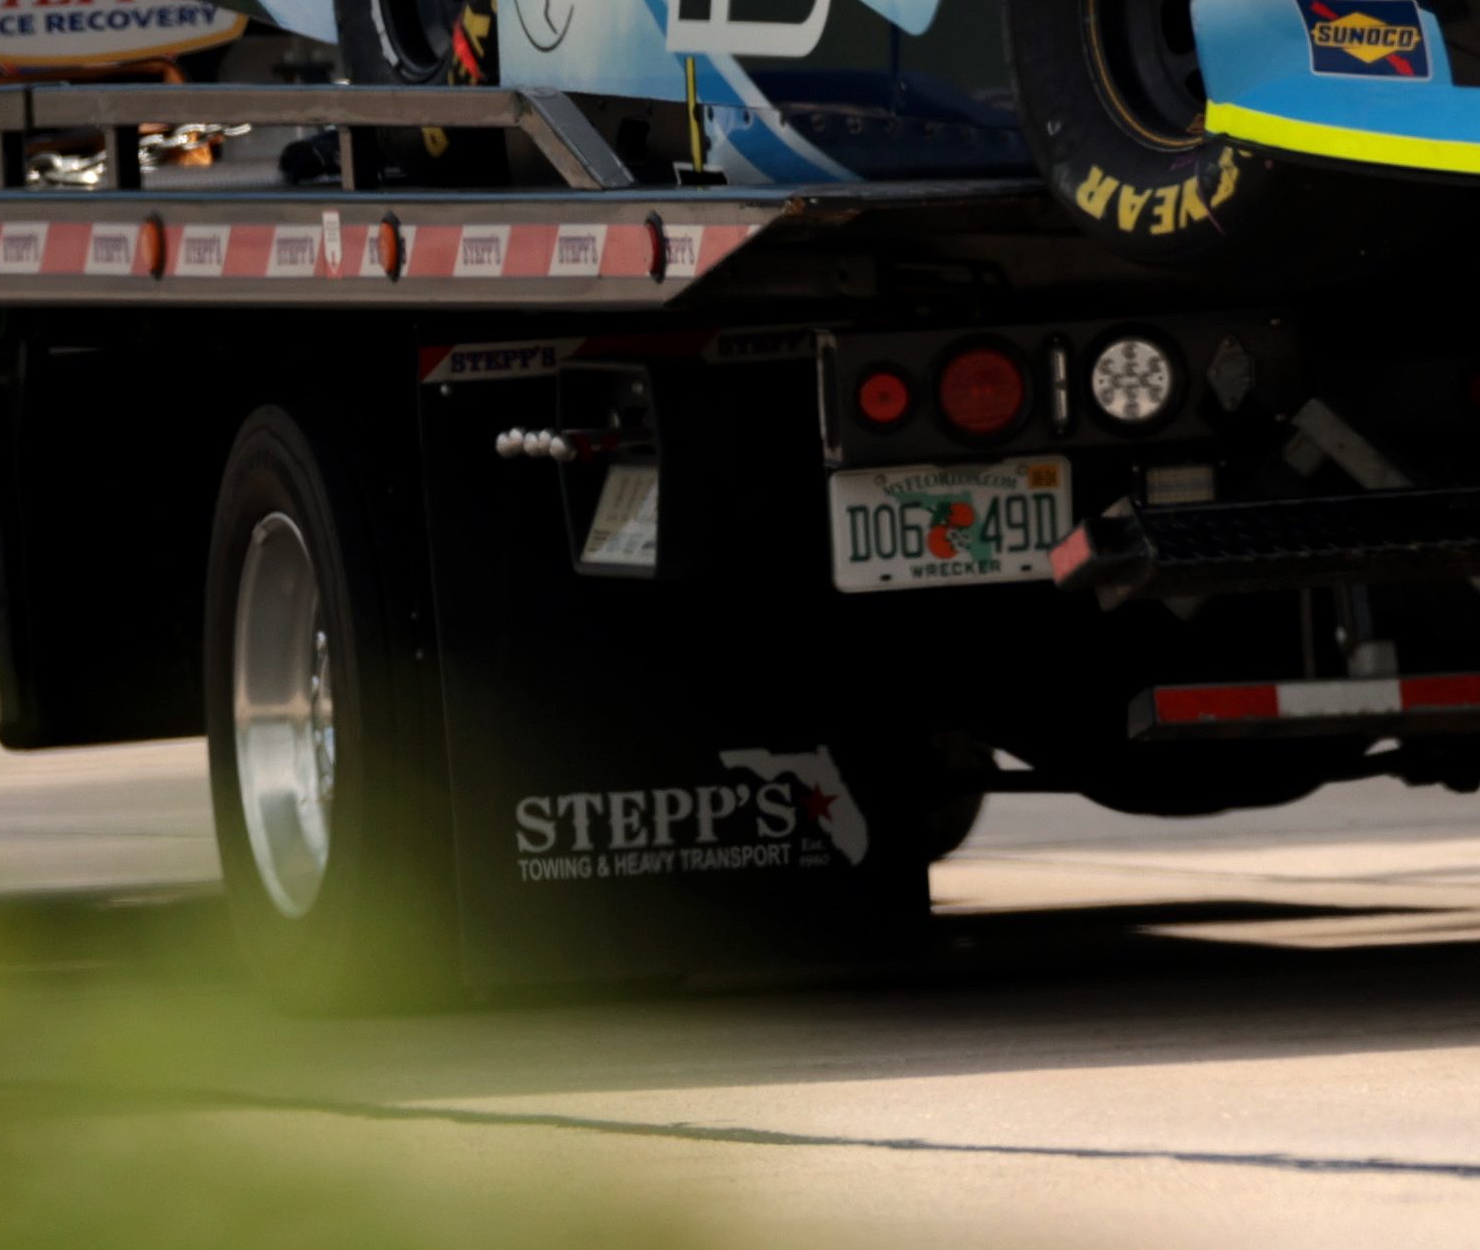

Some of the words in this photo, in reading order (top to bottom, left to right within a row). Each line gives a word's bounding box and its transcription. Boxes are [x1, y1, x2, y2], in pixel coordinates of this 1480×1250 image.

[45, 5, 217, 33] RECOVERY
[1317, 24, 1414, 48] SUNOCO
[450, 345, 557, 373] STEPP'S
[980, 493, 1059, 554] 49D
[910, 559, 1002, 578] WRECKER
[515, 781, 798, 854] STEPP'S
[517, 856, 593, 882] TOWING
[597, 855, 611, 878] &
[614, 850, 678, 876] HEAVY
[679, 842, 792, 871] TRANSPORT
